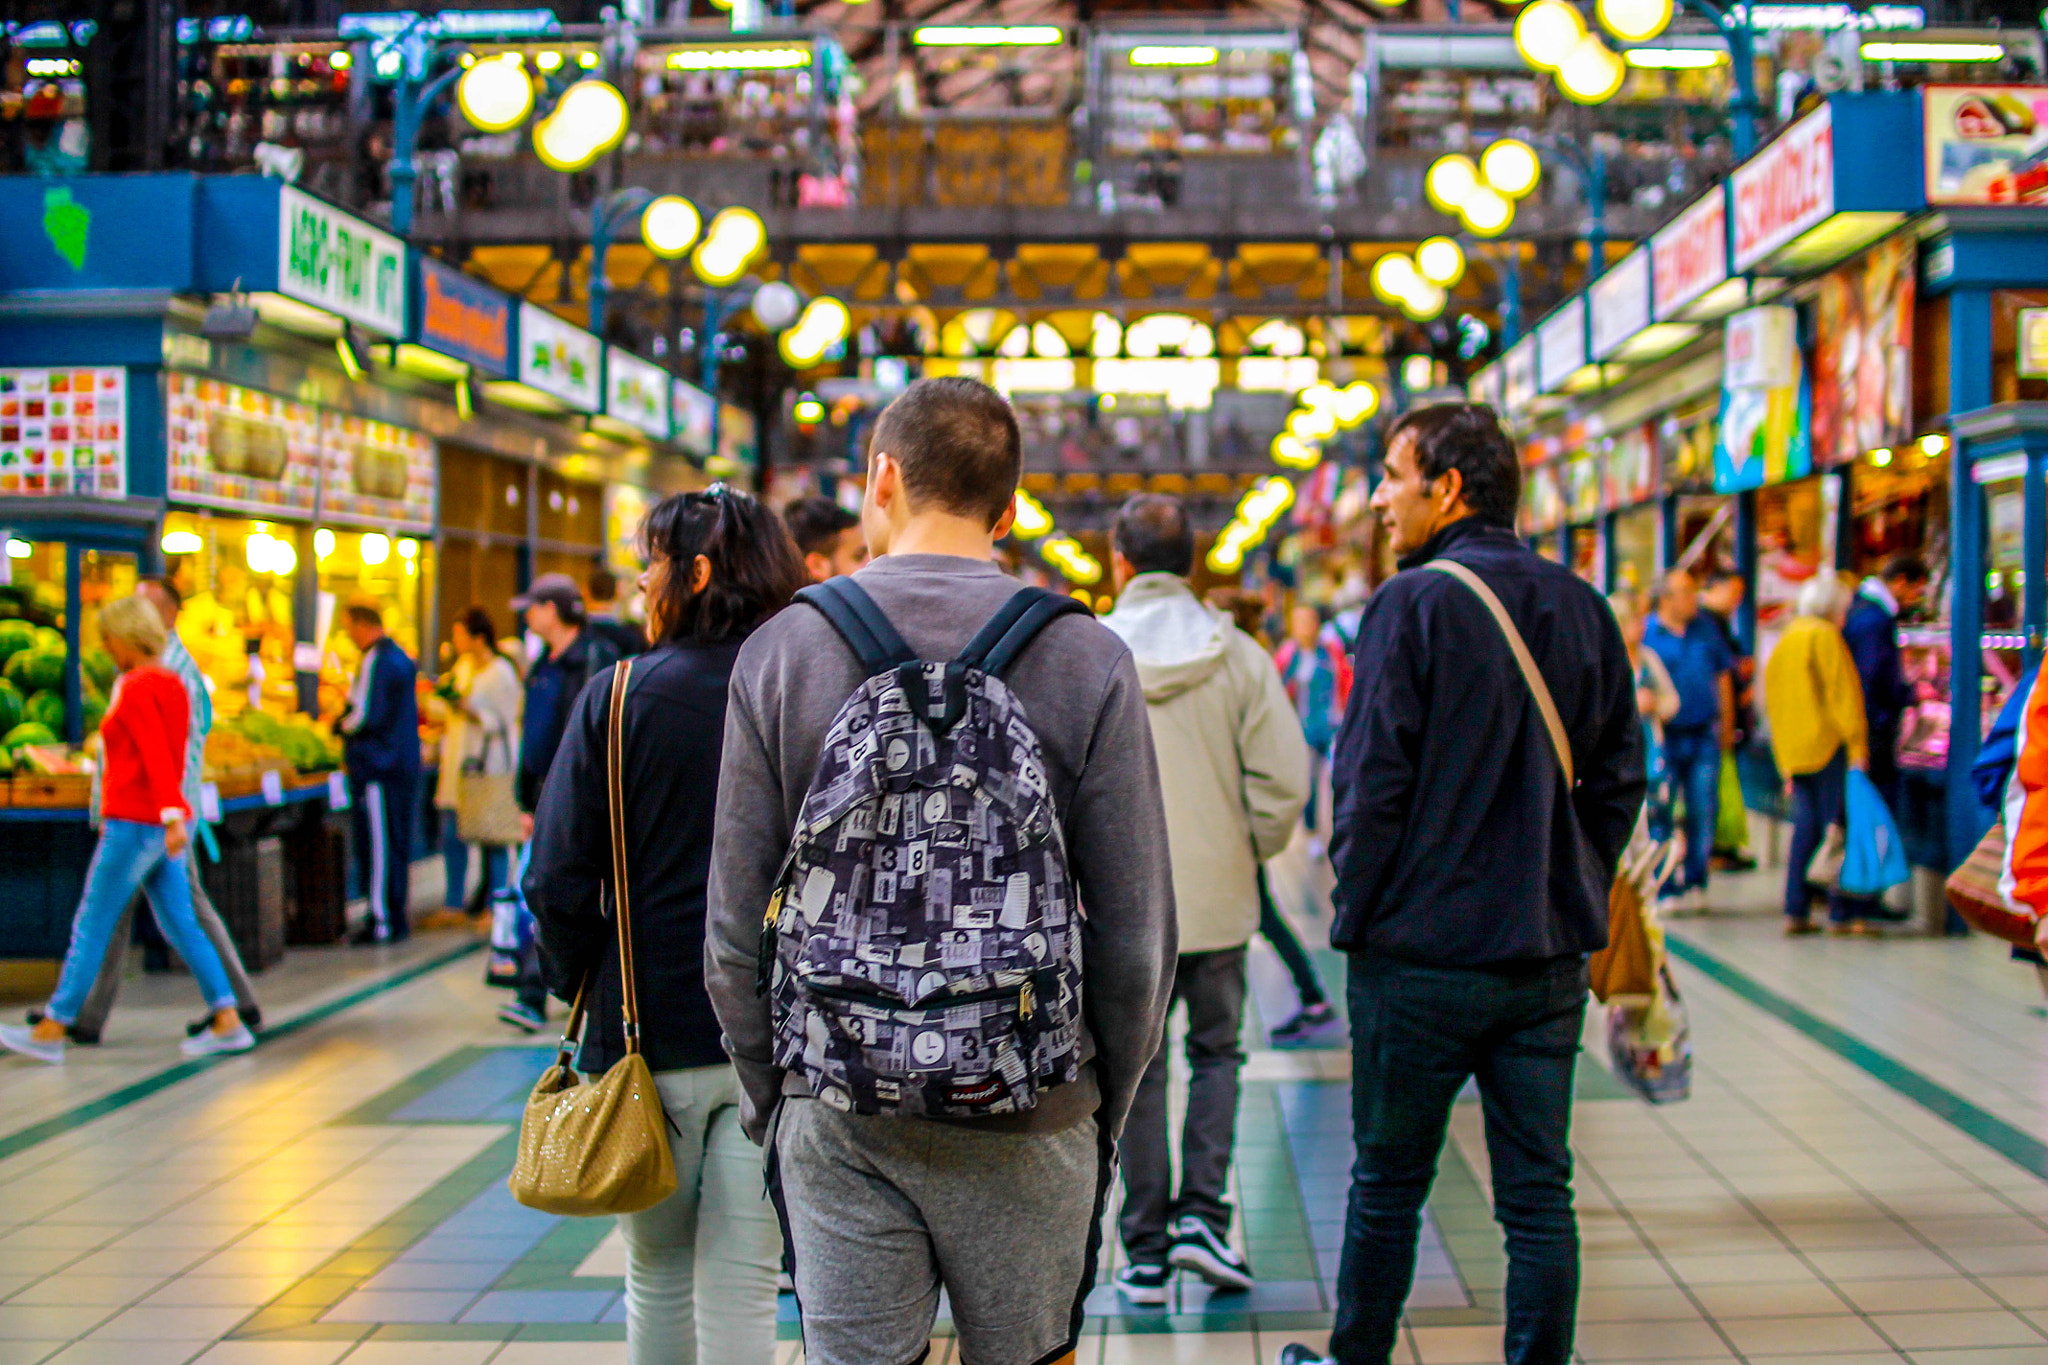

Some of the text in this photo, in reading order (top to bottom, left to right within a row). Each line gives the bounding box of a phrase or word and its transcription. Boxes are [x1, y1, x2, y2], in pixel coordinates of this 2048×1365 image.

[880, 846, 898, 871] 3
[913, 850, 923, 870] 8
[961, 1035, 979, 1060] 3
